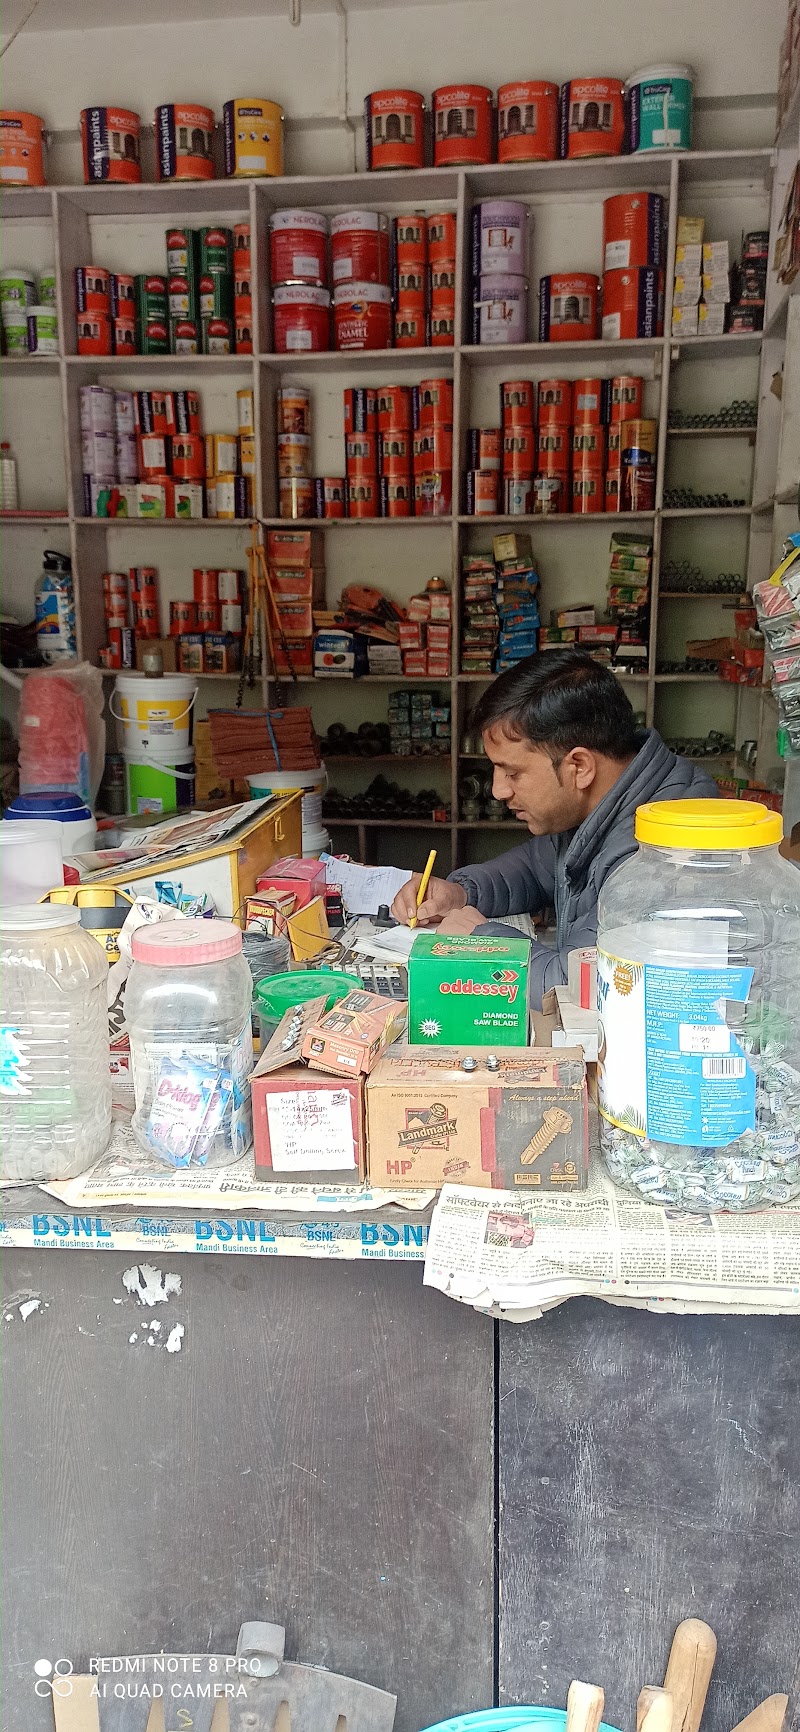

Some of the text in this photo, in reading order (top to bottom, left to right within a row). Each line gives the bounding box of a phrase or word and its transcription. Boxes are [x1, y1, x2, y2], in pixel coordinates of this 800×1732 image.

[91, 110, 103, 178] asianpaints
[160, 107, 172, 176] asianpaints
[653, 198, 662, 265] asianpaints
[645, 271, 655, 337] asianpaints
[318, 639, 346, 649] wintech
[440, 980, 518, 1004] oddessey
[509, 1094, 534, 1102] Always
[400, 1121, 456, 1142] Landmark
[386, 1160, 413, 1175] HP
[142, 1225, 171, 1237] BSNL
[307, 1230, 336, 1242] BSNL
[361, 1222, 430, 1247] BSN
[33, 1239, 115, 1248] Mandi Business Area
[196, 1243, 278, 1253] Mandi Business Area
[362, 1248, 425, 1258] Mandi Business
